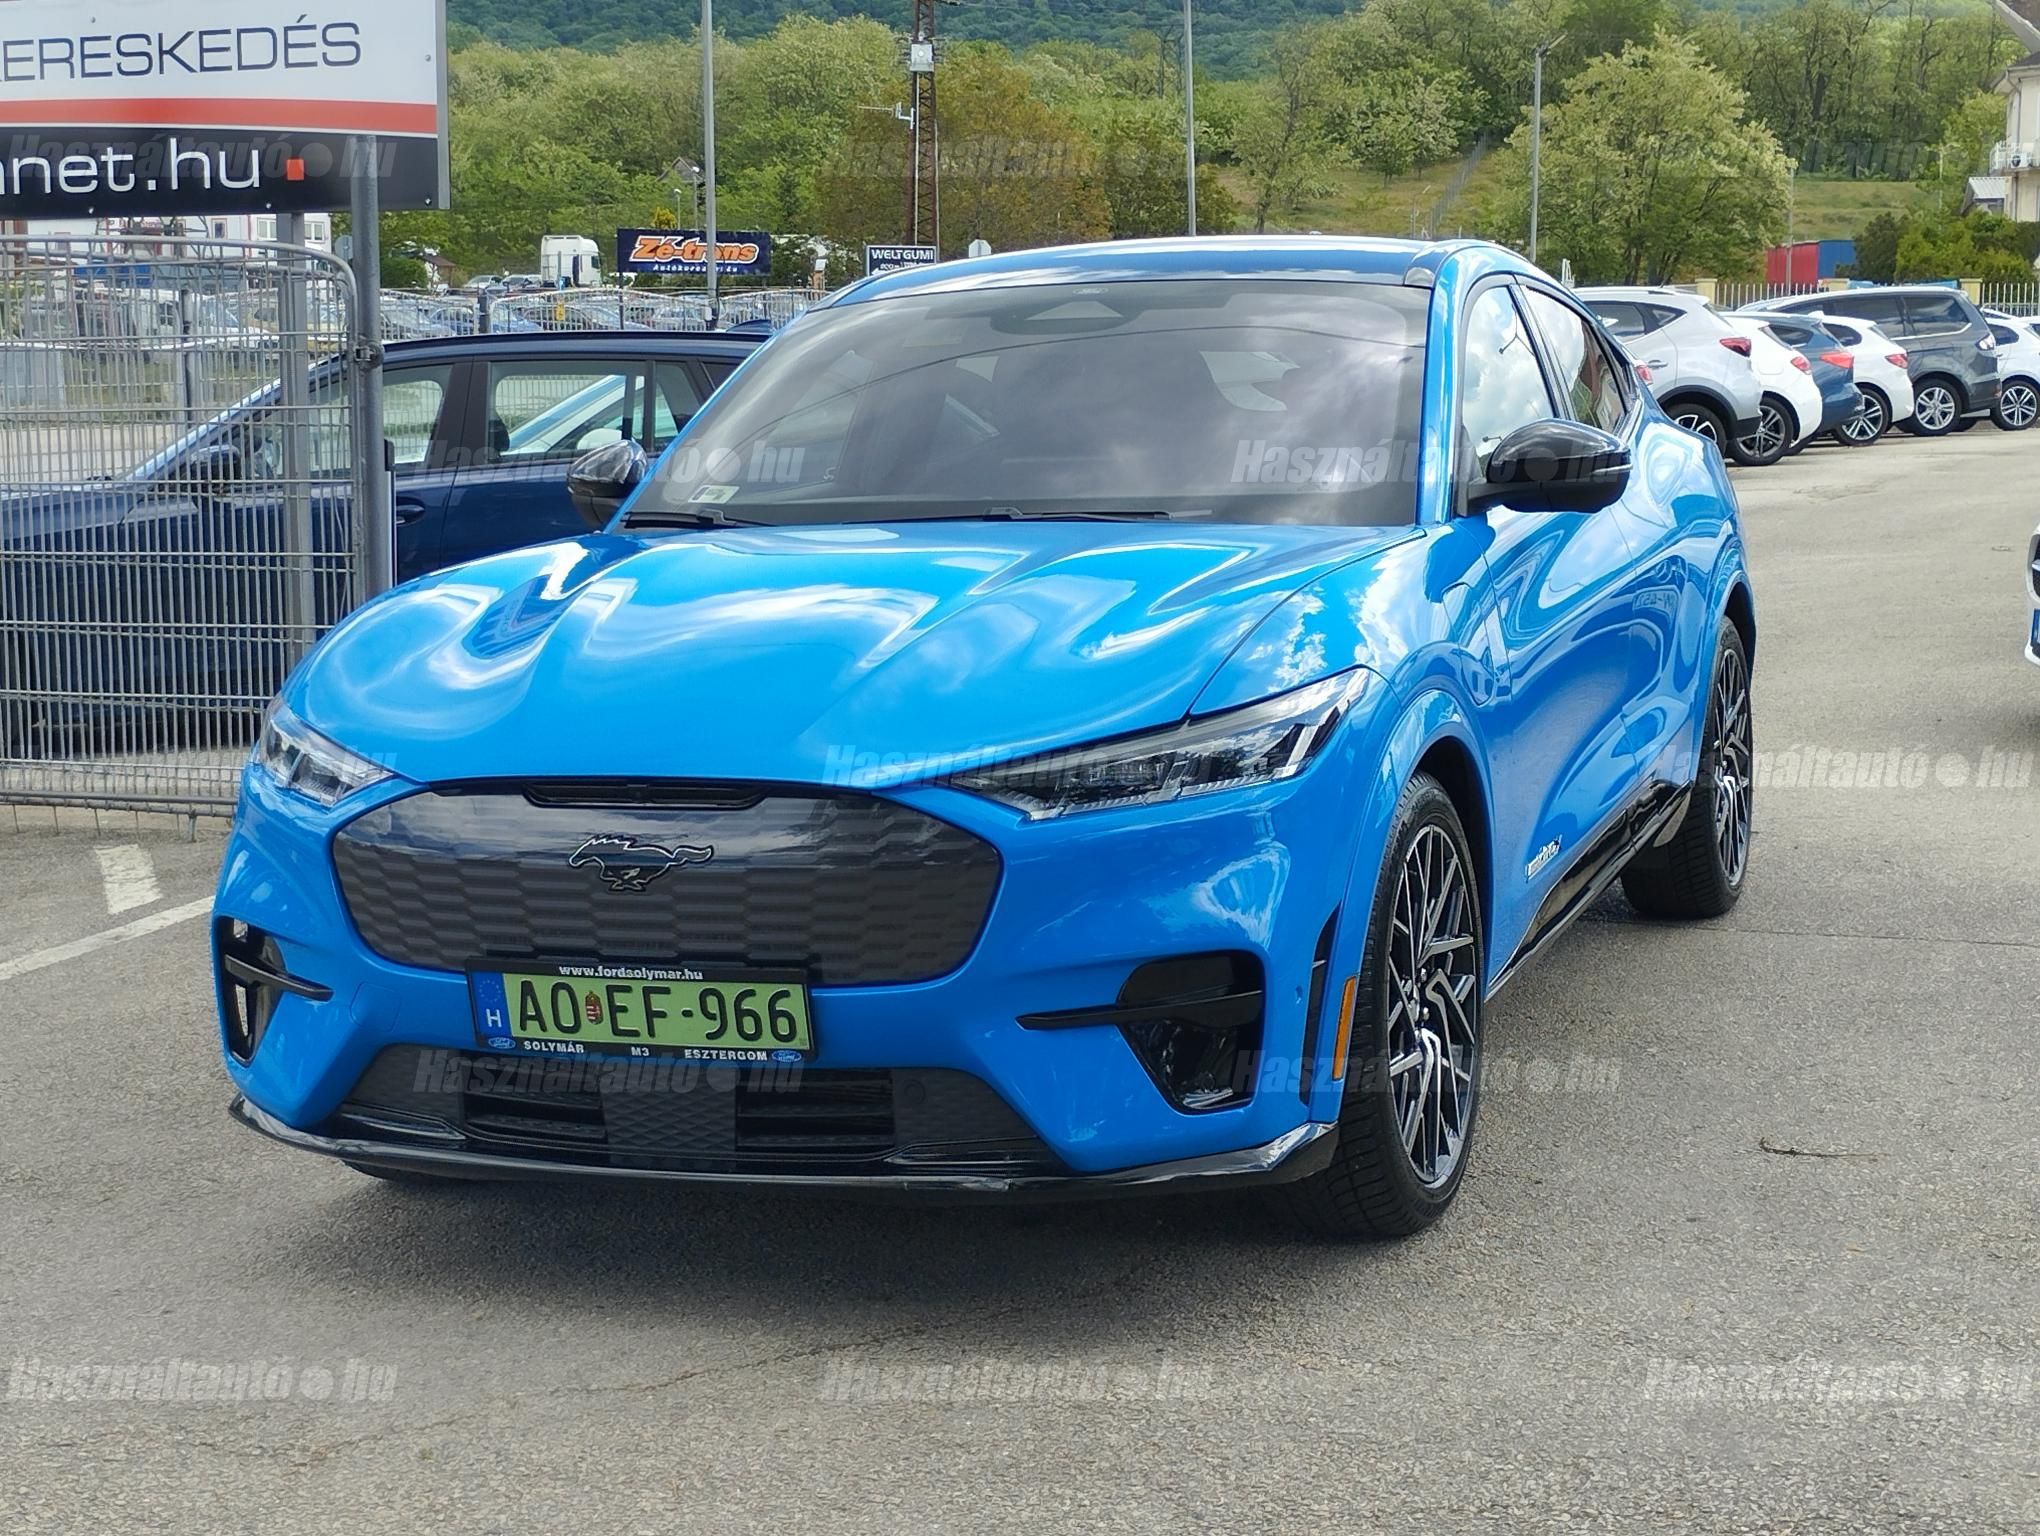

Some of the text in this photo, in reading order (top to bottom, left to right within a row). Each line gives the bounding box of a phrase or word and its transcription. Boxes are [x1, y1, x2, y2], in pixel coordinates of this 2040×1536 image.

[0, 14, 361, 82] ERESKEDÉS
[559, 965, 704, 981] www.fordsolymar.hu
[485, 1008, 503, 1028] H
[605, 984, 798, 1043] EF-966
[524, 1040, 585, 1054] SOLYMÁR
[631, 1046, 651, 1057] M3
[684, 1048, 768, 1062] ESZTERGOM
